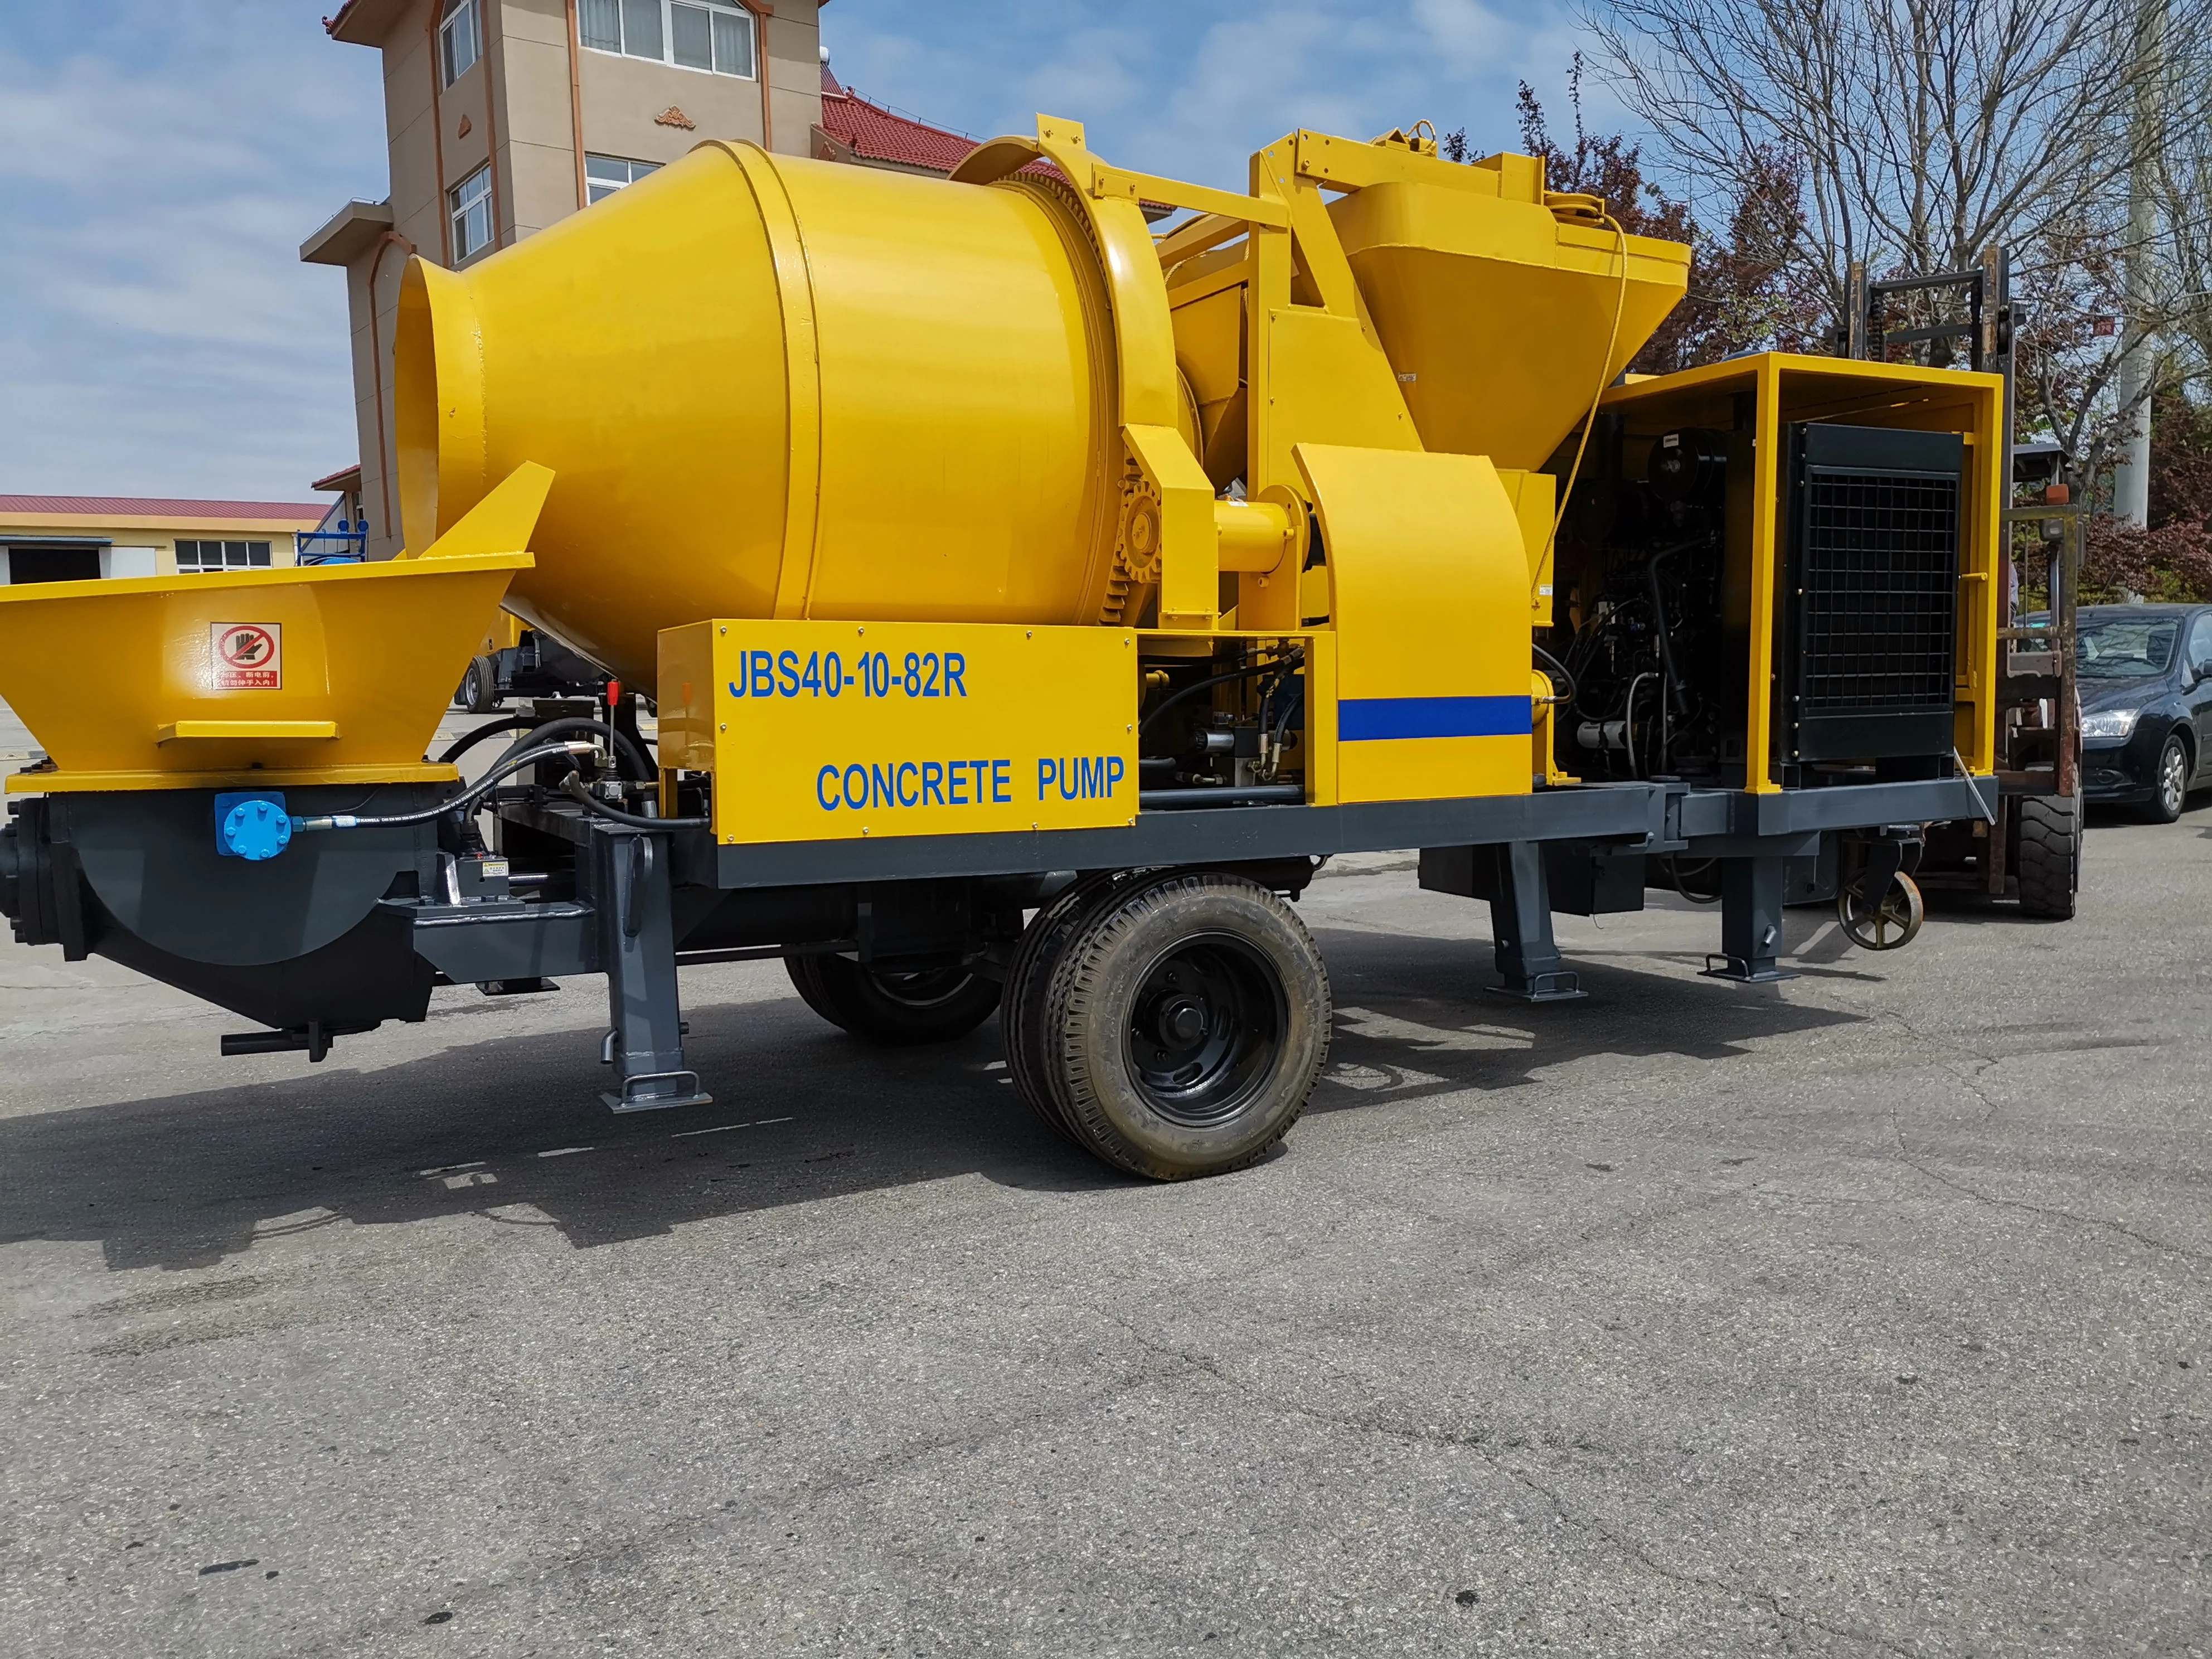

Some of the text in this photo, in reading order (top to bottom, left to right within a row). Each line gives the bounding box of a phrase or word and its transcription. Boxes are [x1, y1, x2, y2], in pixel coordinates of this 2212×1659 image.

[729, 650, 967, 698] JBS40-10-82R
[817, 756, 1124, 811] CONCRETE PUMP
